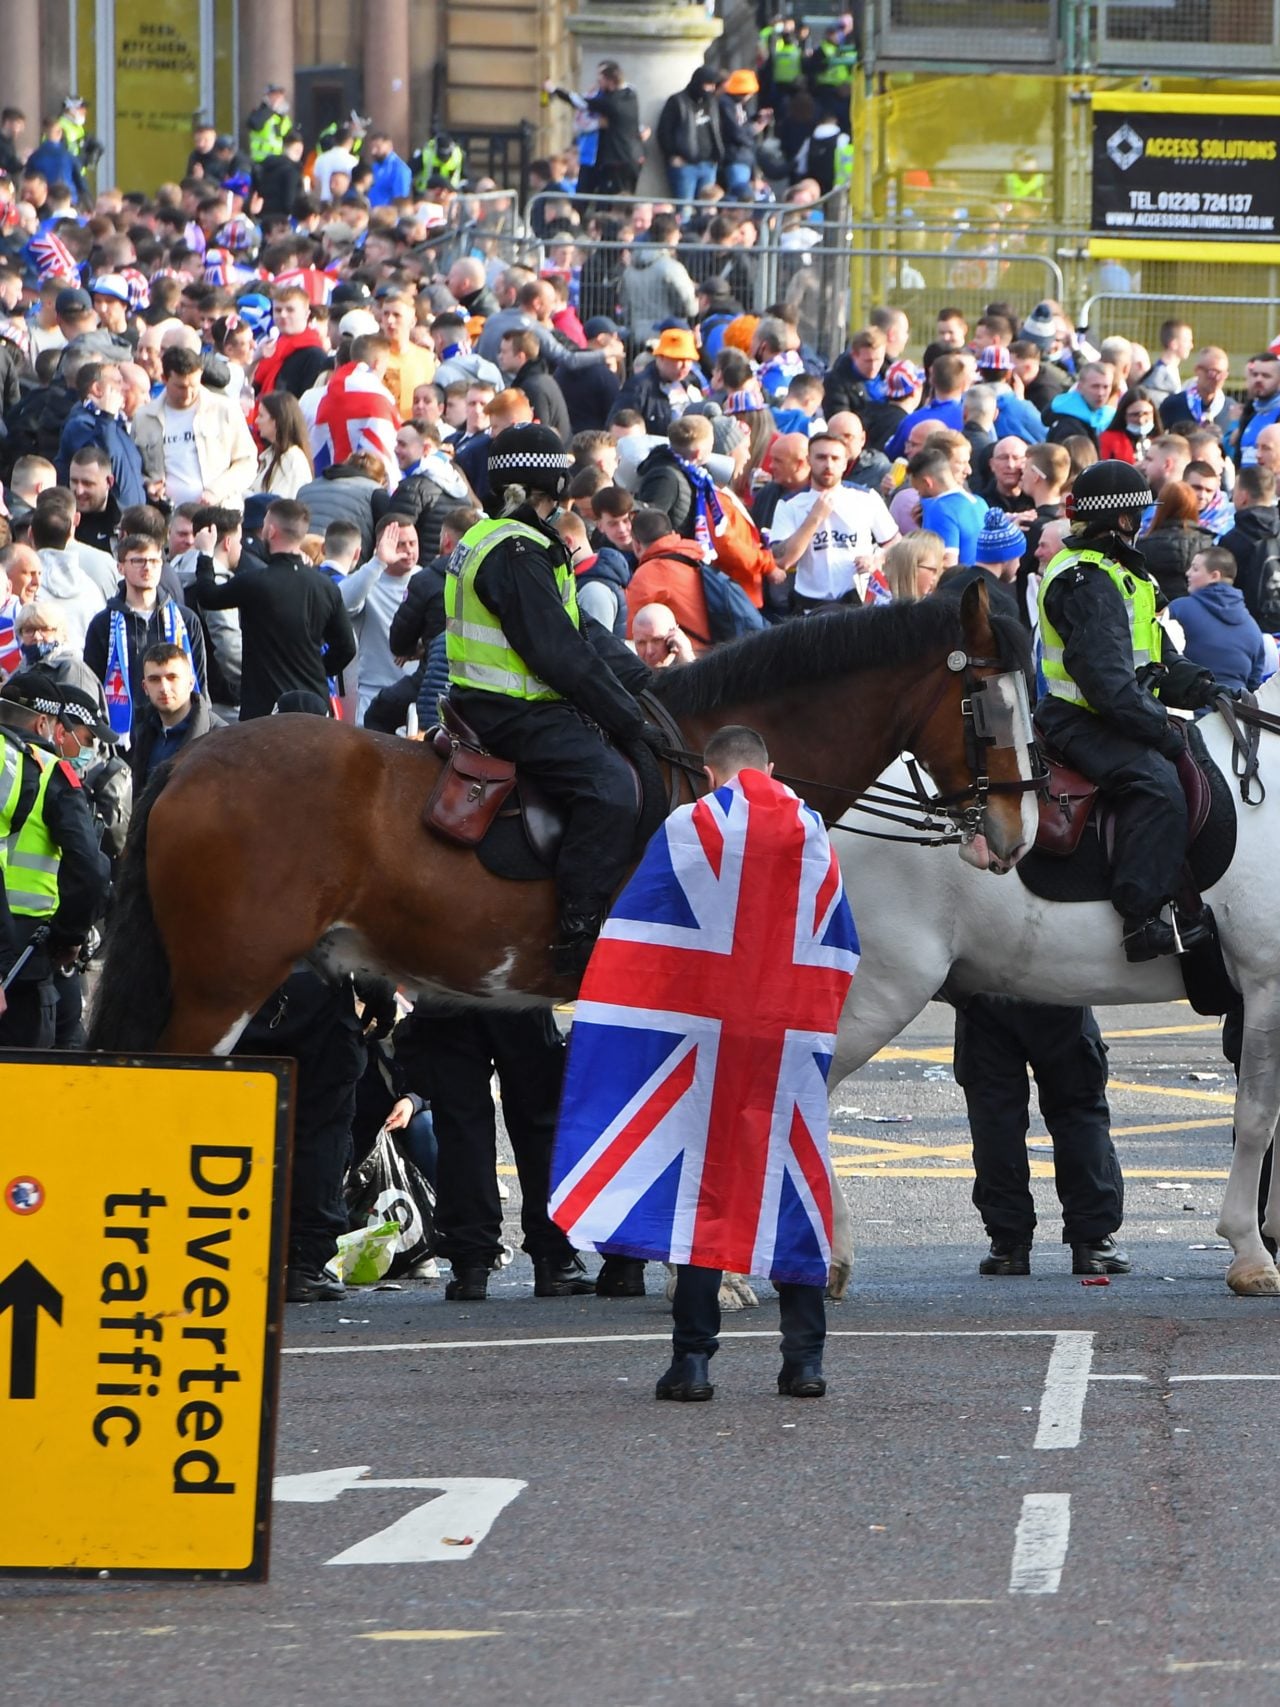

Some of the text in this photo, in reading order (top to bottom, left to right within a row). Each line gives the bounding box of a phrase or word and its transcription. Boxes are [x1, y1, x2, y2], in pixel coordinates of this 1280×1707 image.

[1145, 137, 1277, 160] ACCESS SOLUTIONS
[1202, 193, 1253, 213] 724137
[92, 1187, 168, 1448] traffic
[172, 1144, 253, 1495] Diverted
